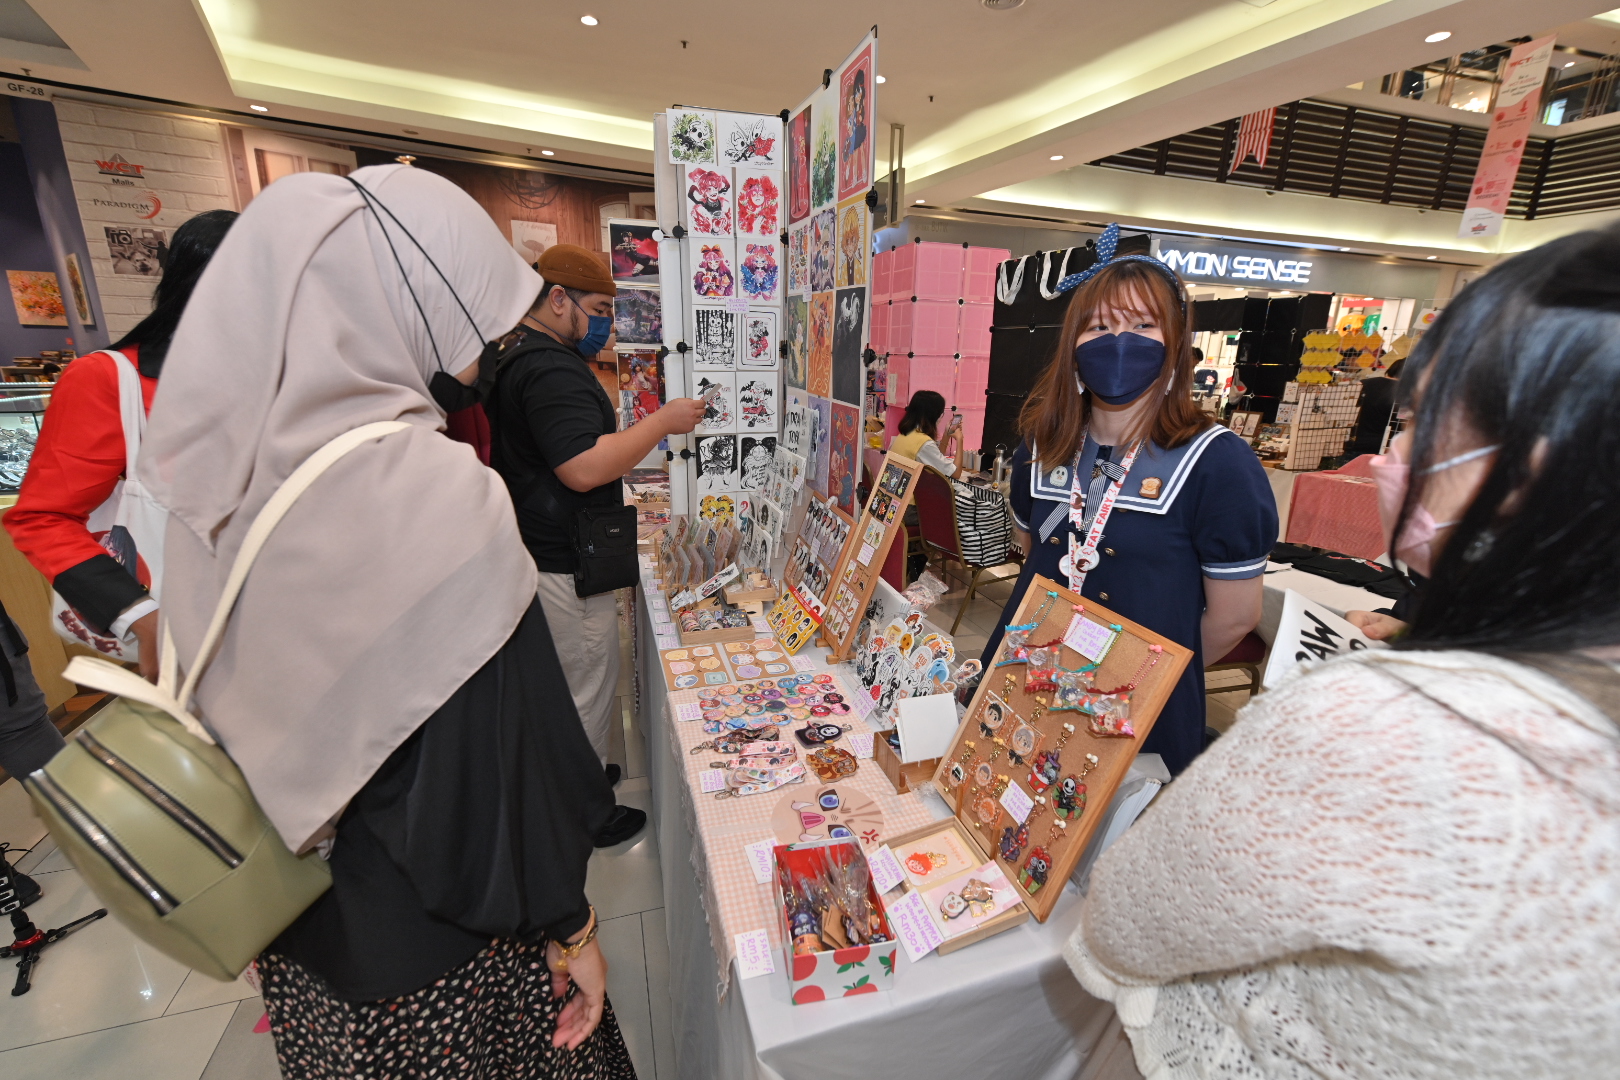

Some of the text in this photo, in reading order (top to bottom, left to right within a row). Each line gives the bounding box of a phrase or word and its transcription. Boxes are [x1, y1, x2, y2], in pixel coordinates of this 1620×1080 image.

[7, 82, 45, 96] GF-28
[95, 159, 145, 175] WCT
[112, 177, 135, 187] Malls
[93, 198, 150, 211] PARADIGM
[1231, 256, 1313, 284] SENSE
[1087, 496, 1114, 548] FAT FAIRY
[753, 849, 771, 874] RM10
[870, 860, 889, 886] RM20
[904, 902, 922, 930] WOODEN
[909, 893, 920, 907] BEE
[921, 915, 944, 945] PUPPYCAT
[896, 913, 918, 947] RM30
[746, 938, 760, 965] RM5
